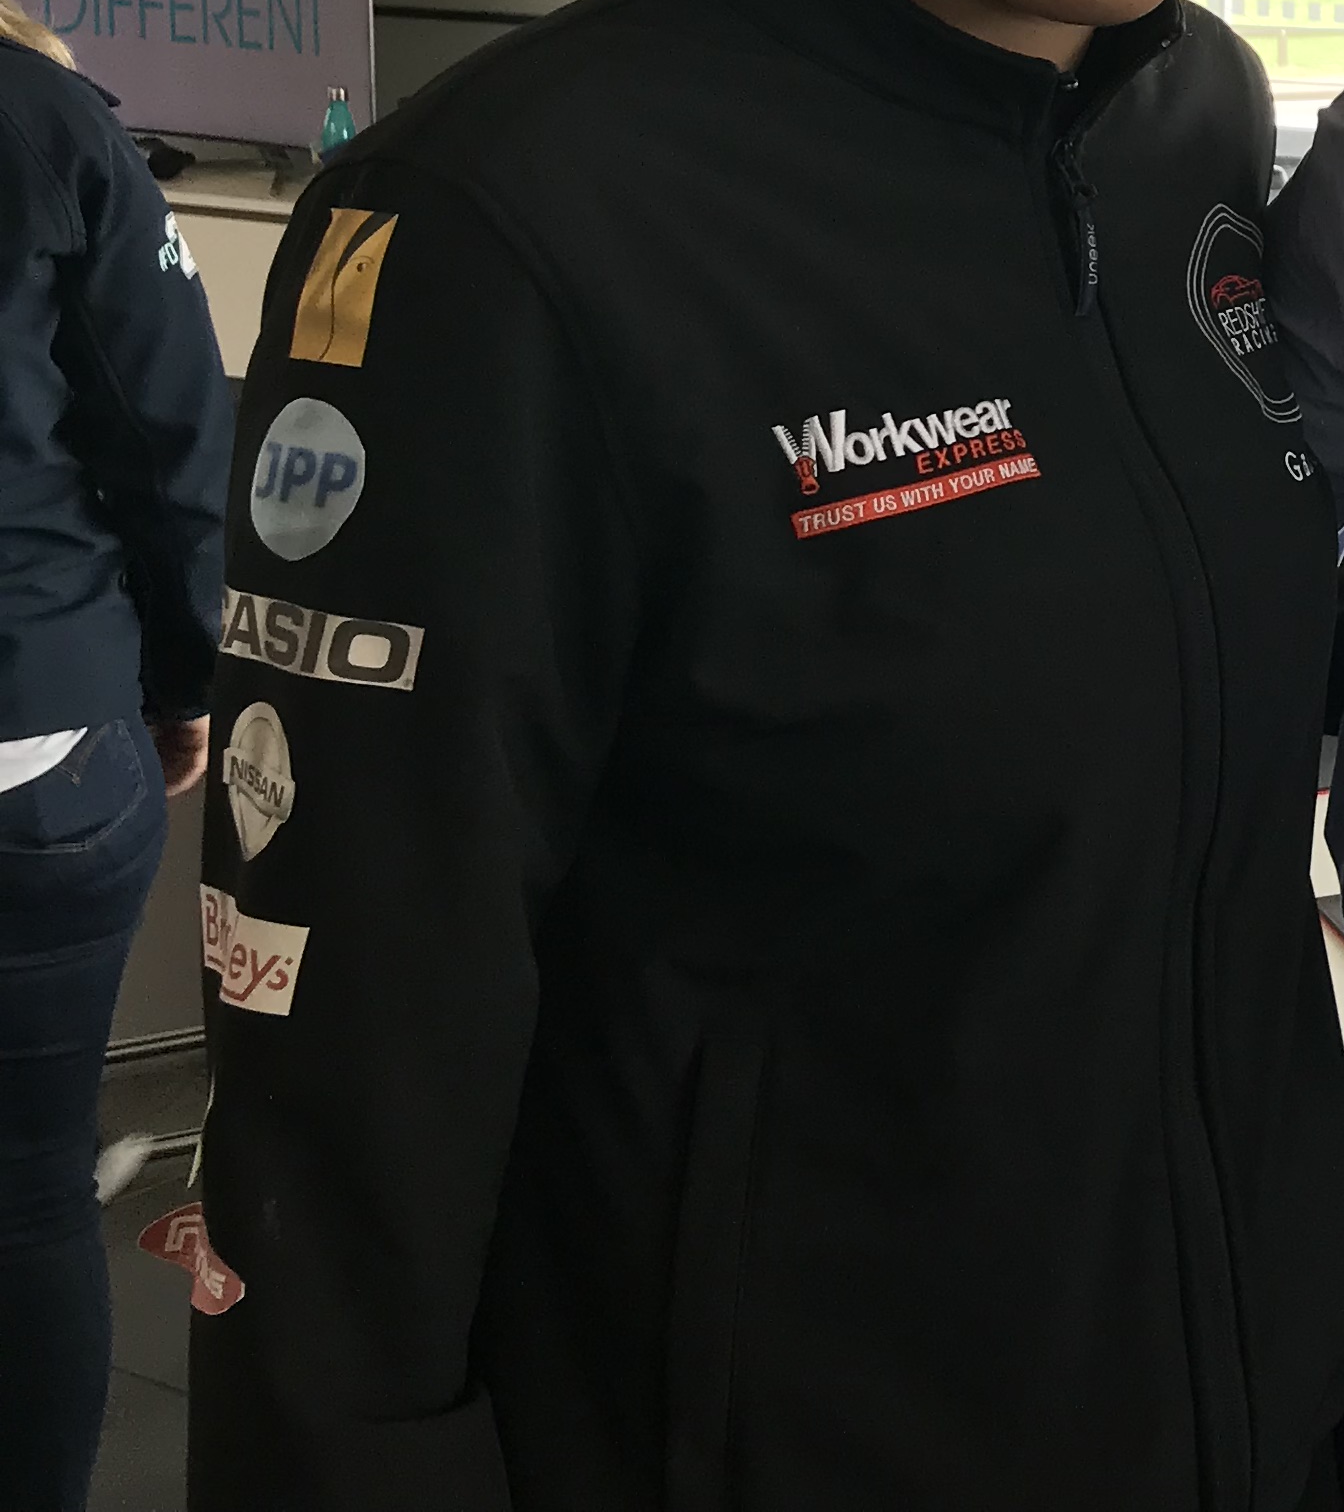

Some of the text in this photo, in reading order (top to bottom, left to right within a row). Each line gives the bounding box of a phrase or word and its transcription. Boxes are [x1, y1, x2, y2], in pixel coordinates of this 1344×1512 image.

[771, 398, 1014, 477] Workwear
[916, 429, 1027, 475] EXPRESS
[254, 440, 359, 508] JPP
[799, 456, 1039, 533] TRUST US WITH YOUR NAME
[221, 592, 411, 684] ASIO
[229, 754, 286, 808] NISSAN
